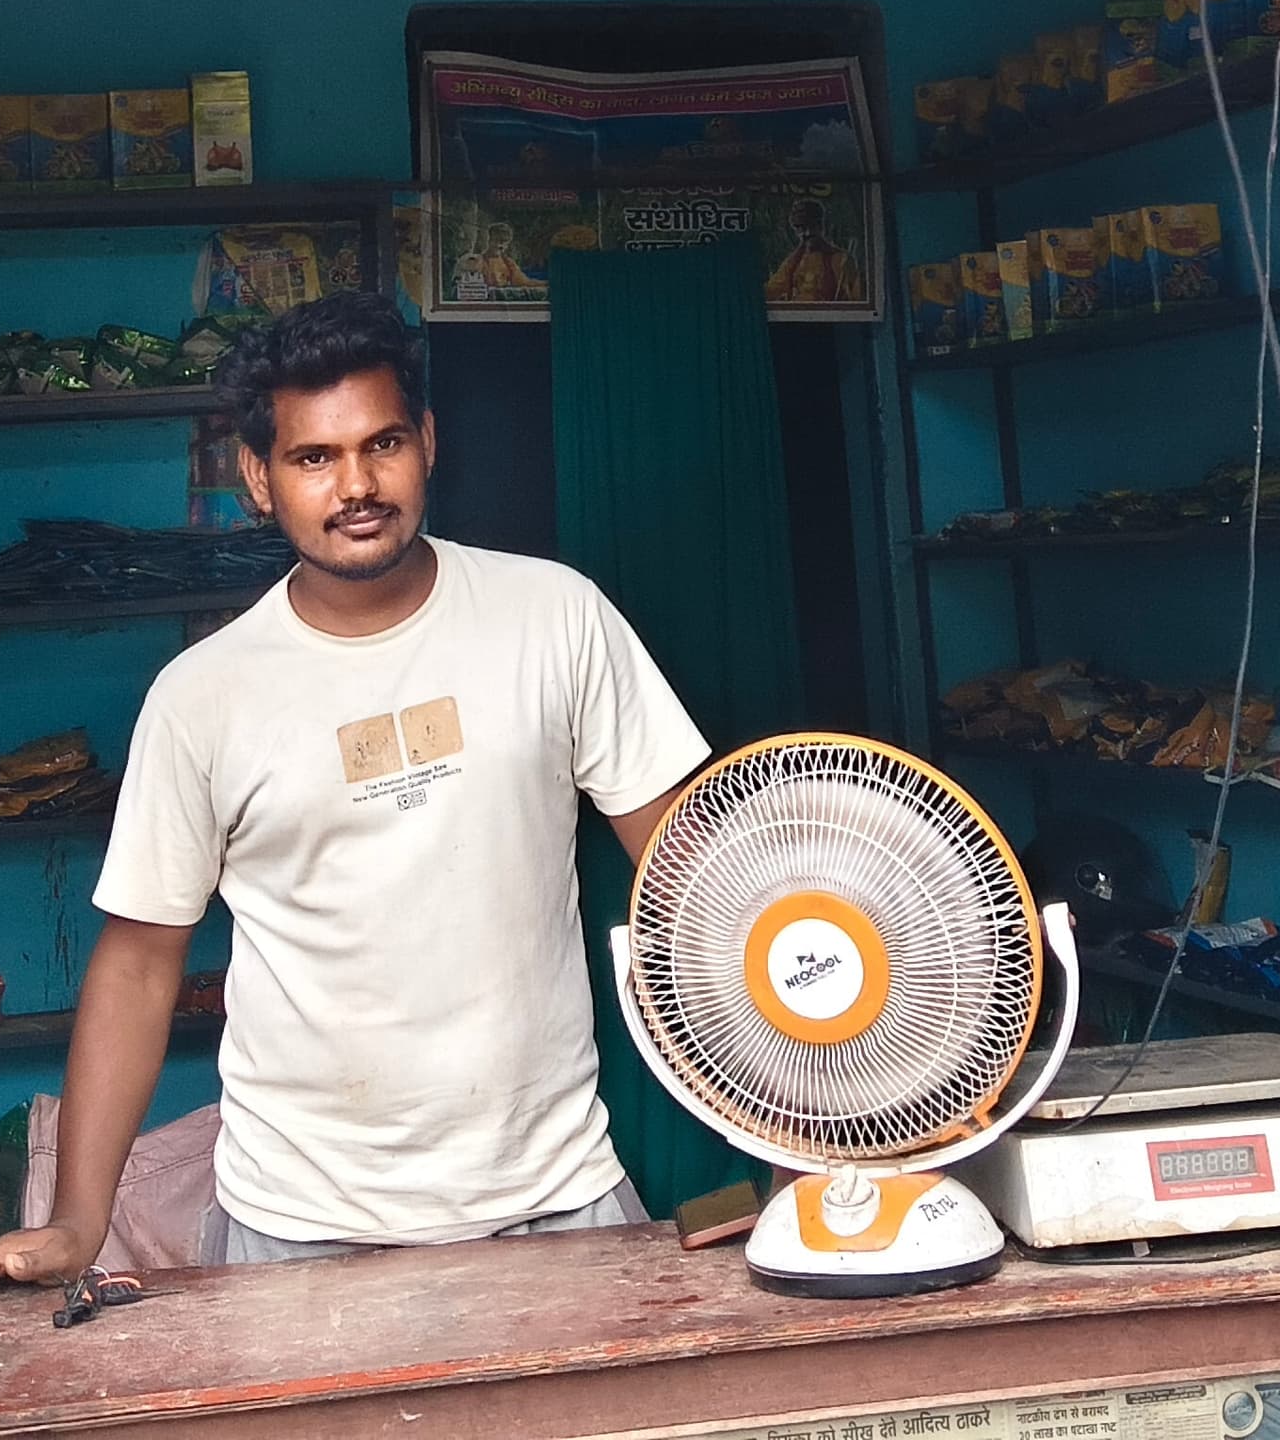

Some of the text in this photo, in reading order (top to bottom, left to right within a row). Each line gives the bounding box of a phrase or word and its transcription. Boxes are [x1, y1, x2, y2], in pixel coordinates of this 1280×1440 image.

[624, 198, 751, 233] संशोधित
[784, 954, 843, 990] NEOCOOL
[902, 1411, 951, 1437] आदित्य
[955, 1406, 991, 1431] ठाकरे
